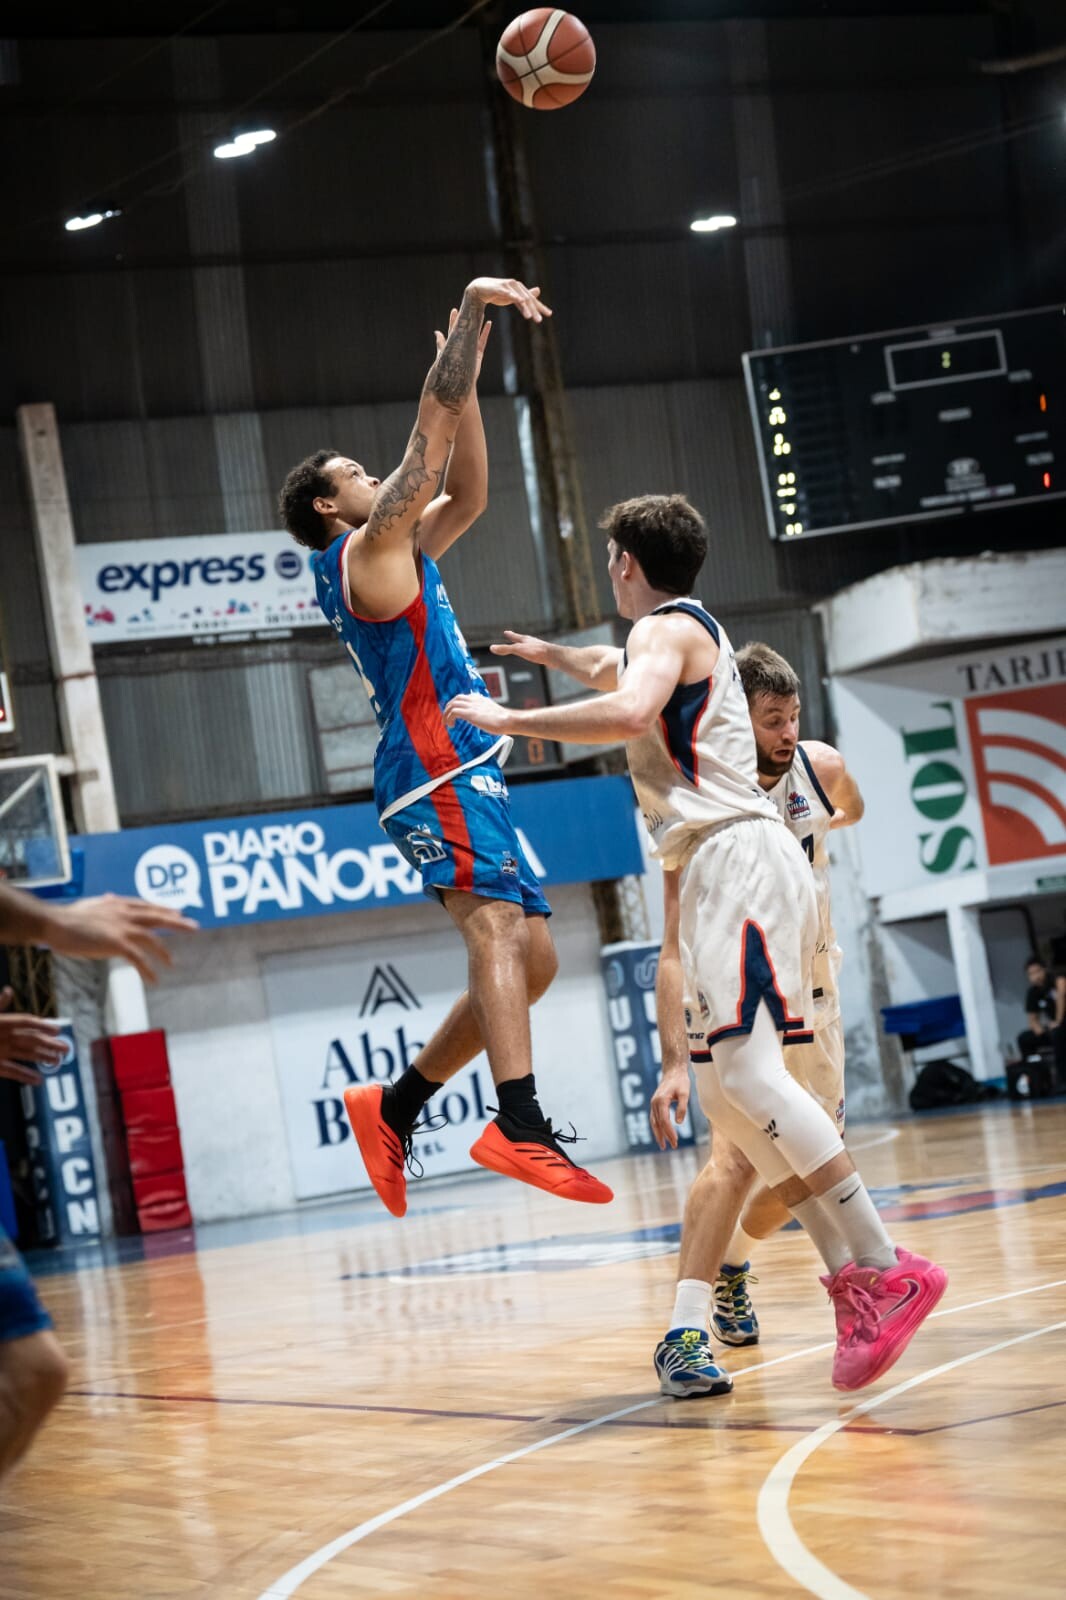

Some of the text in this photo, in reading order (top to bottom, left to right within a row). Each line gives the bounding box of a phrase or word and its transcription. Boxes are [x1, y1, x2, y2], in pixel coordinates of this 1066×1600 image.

[97, 553, 265, 601] express
[901, 701, 977, 875] SOL
[203, 821, 324, 865] DIARIO
[147, 862, 188, 889] DP
[46, 1073, 100, 1235] UPCN
